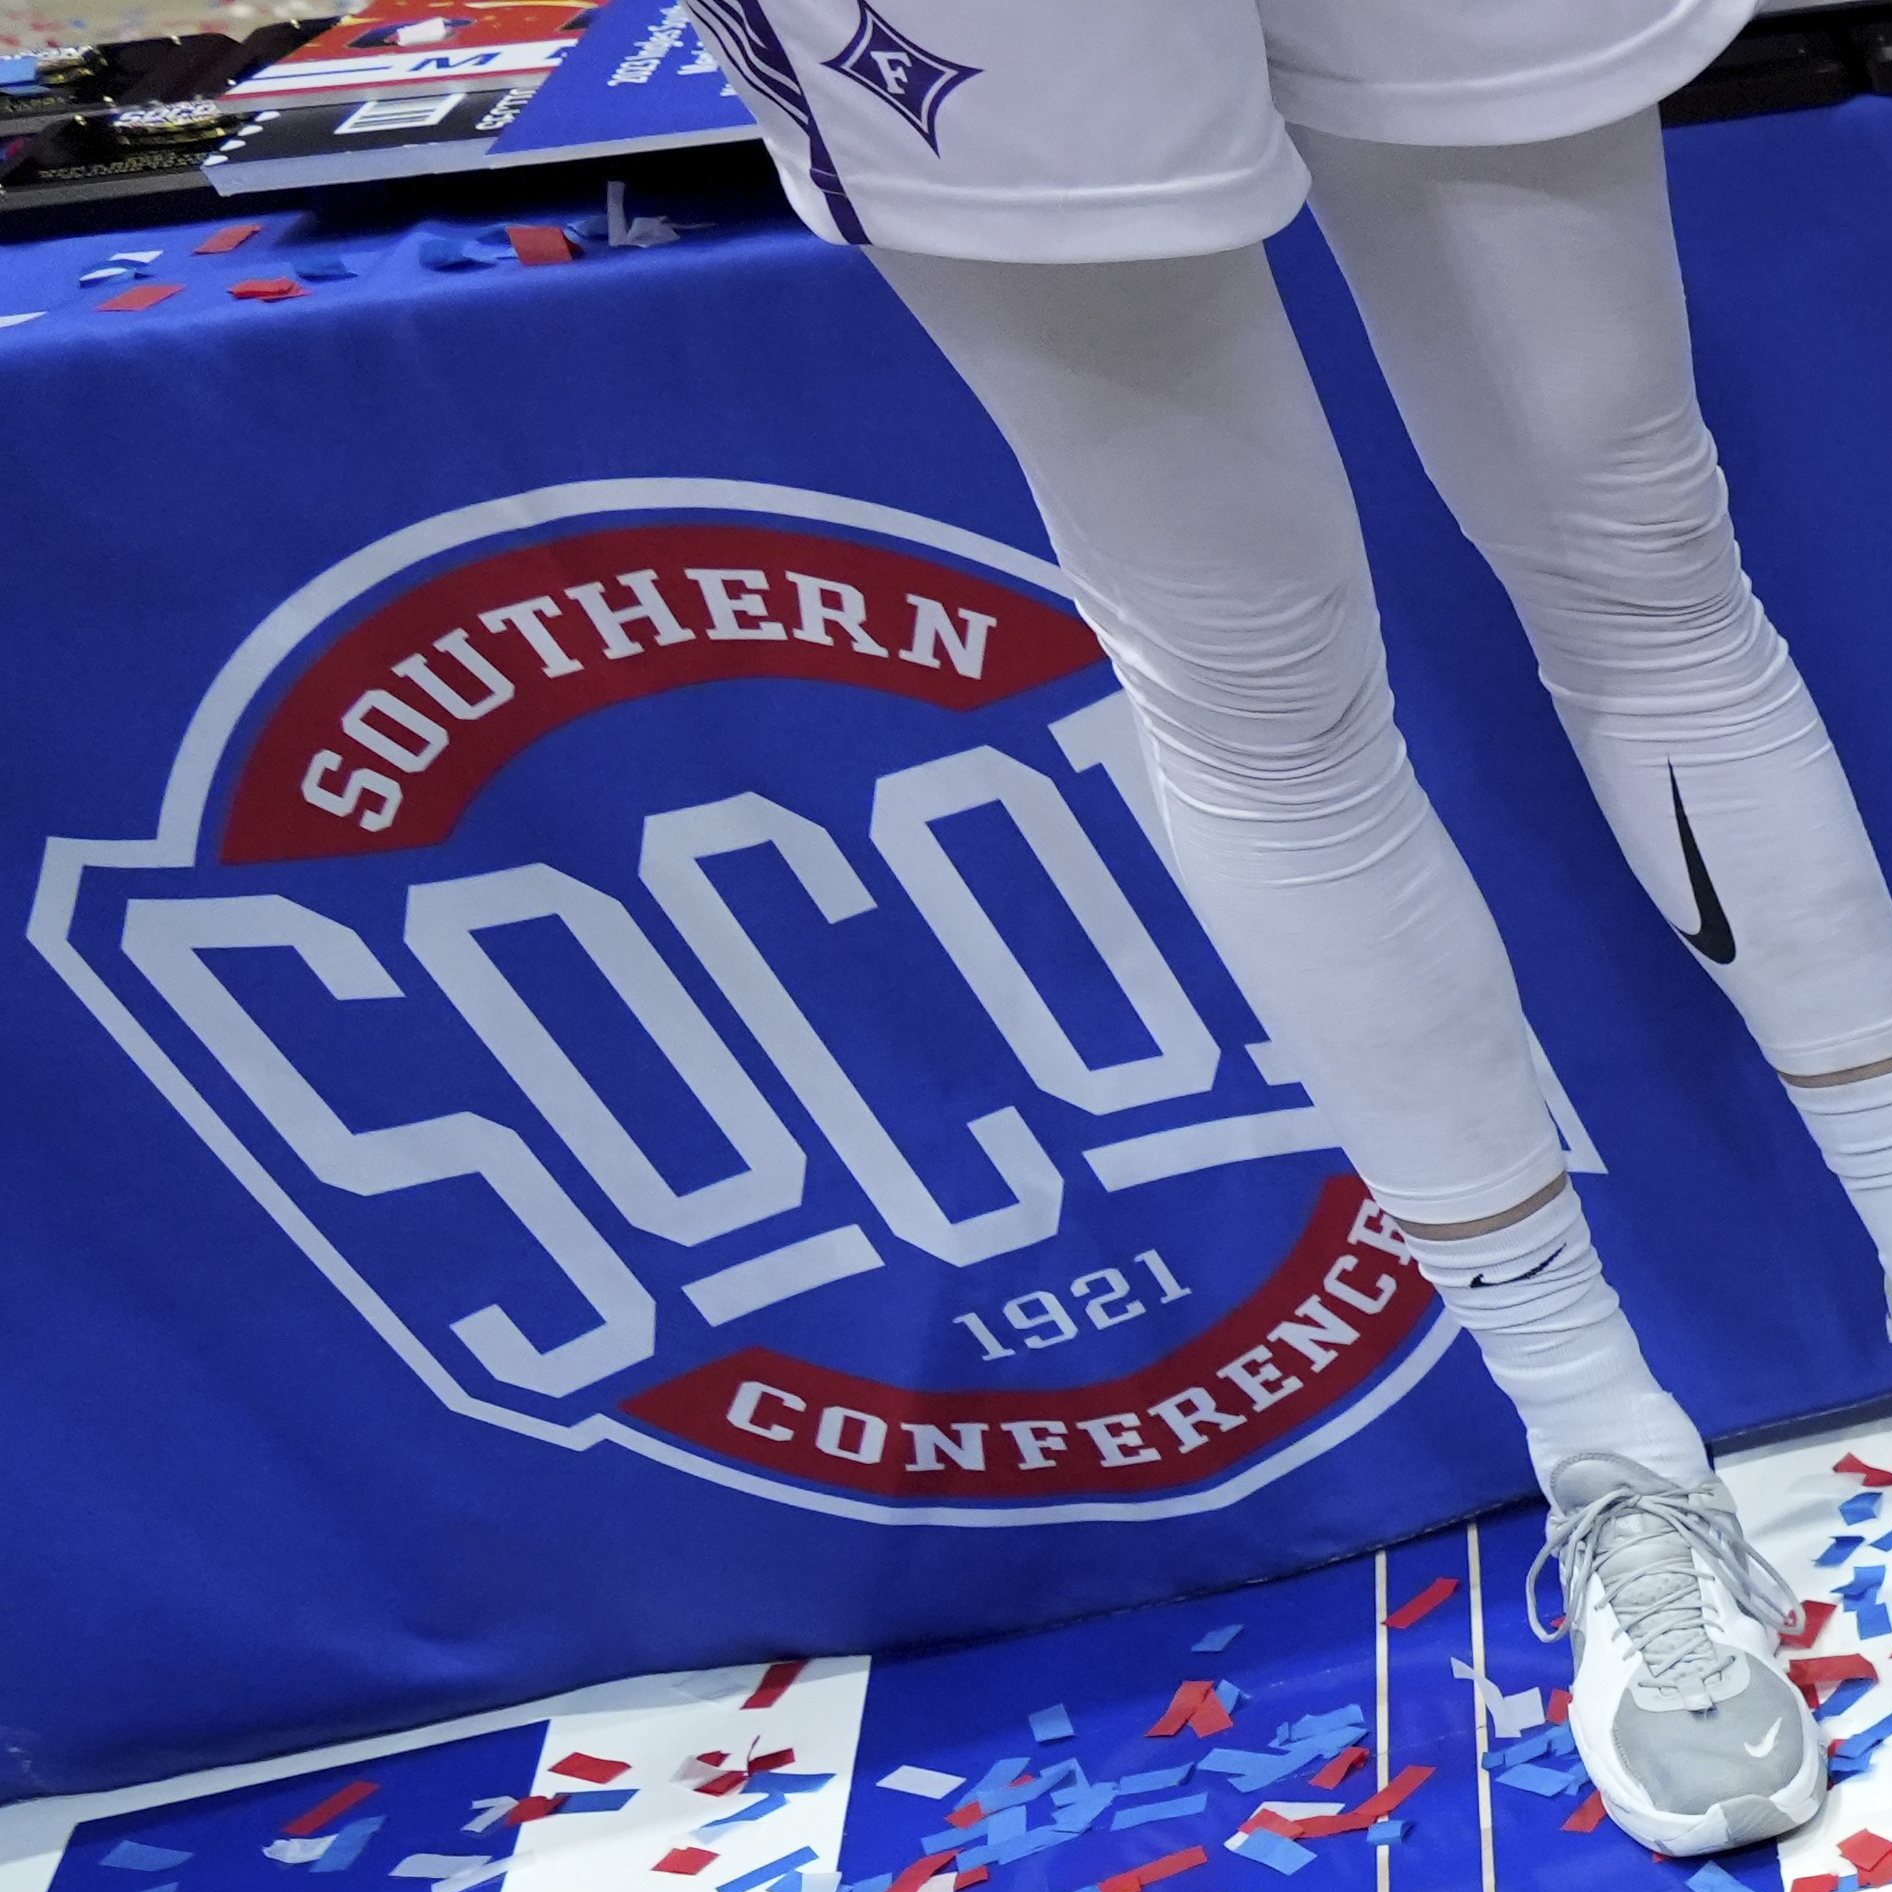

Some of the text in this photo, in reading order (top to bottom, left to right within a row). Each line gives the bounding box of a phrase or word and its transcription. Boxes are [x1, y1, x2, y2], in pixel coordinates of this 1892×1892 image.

[301, 564, 998, 834] SOUTHERN
[725, 1198, 1413, 1475] CONFERENCE
[955, 1249, 1193, 1363] 1921
